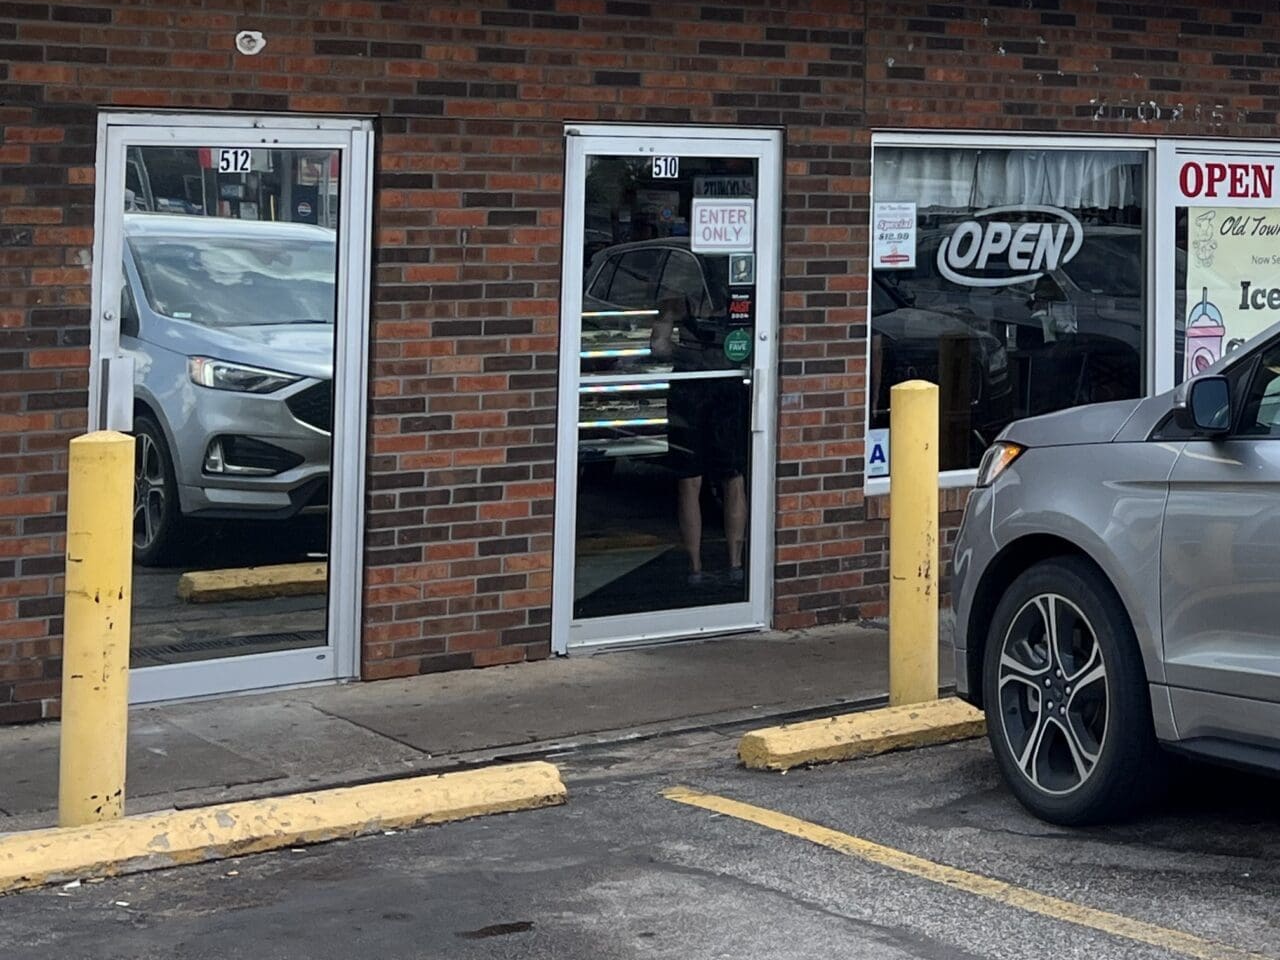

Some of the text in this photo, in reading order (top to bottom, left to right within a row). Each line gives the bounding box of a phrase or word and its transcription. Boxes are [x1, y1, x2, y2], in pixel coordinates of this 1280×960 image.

[220, 149, 250, 171] 512
[654, 156, 678, 177] 510
[1178, 161, 1275, 199] OPEN
[699, 208, 748, 225] ENTER
[1219, 215, 1250, 236] Old
[702, 226, 743, 242] ONLY
[947, 220, 1069, 271] OPEN
[1251, 254, 1271, 265] Now
[869, 443, 886, 464] A
